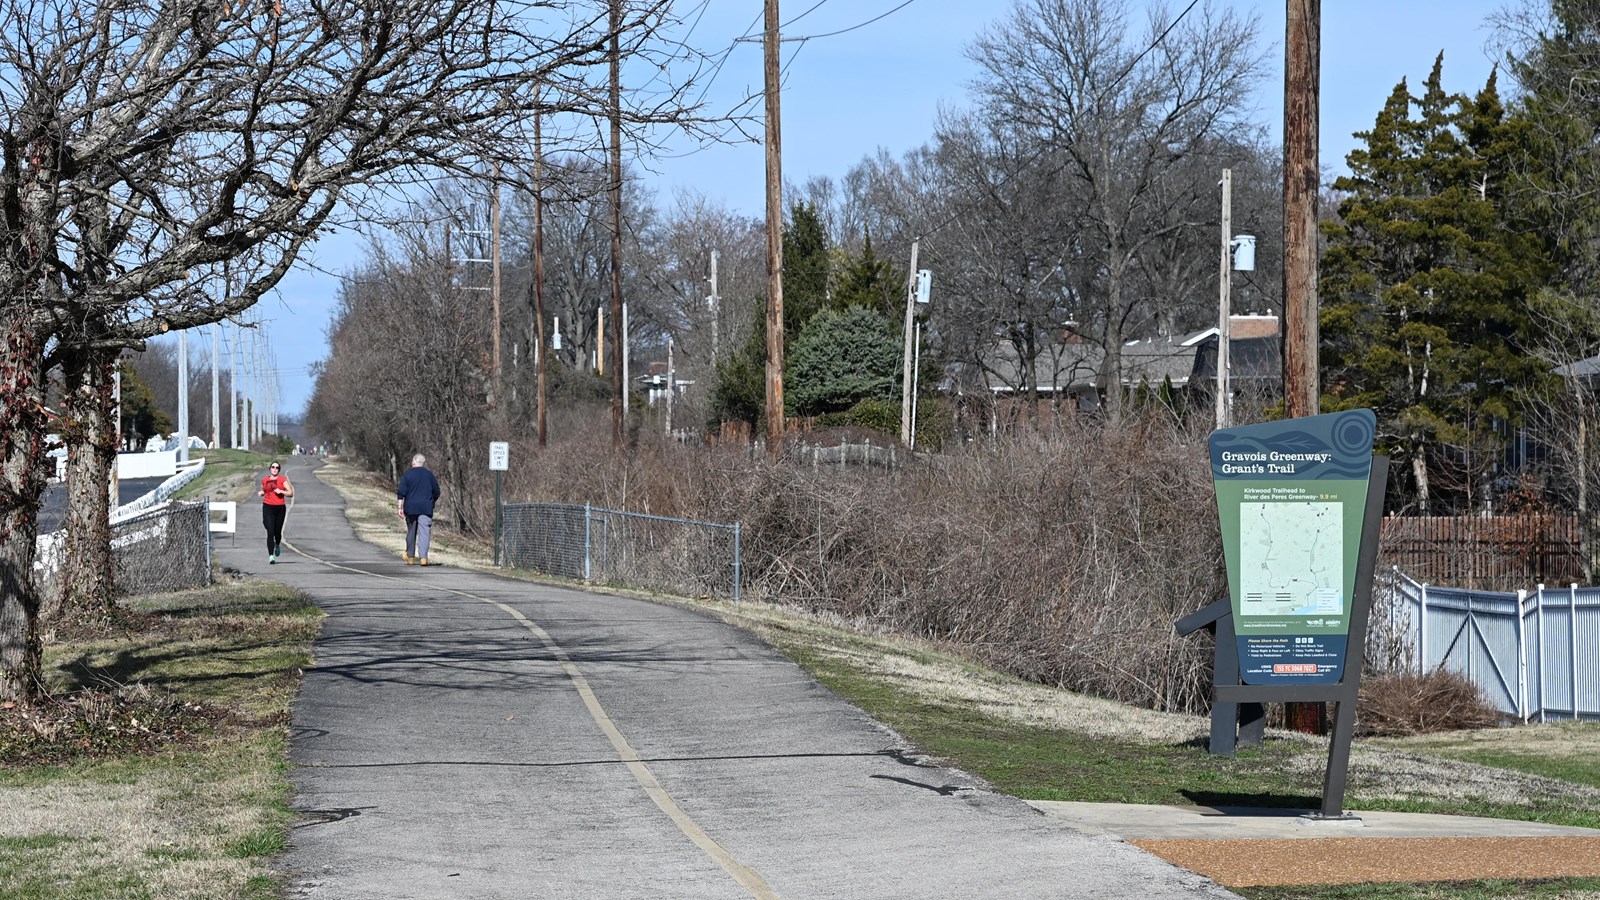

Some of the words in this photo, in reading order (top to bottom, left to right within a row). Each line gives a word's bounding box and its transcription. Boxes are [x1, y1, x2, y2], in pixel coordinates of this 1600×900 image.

[1222, 452, 1266, 461] Gravois
[1270, 452, 1332, 463] Greenway:
[1222, 464, 1264, 473] Grant's
[1267, 464, 1295, 473] Trail
